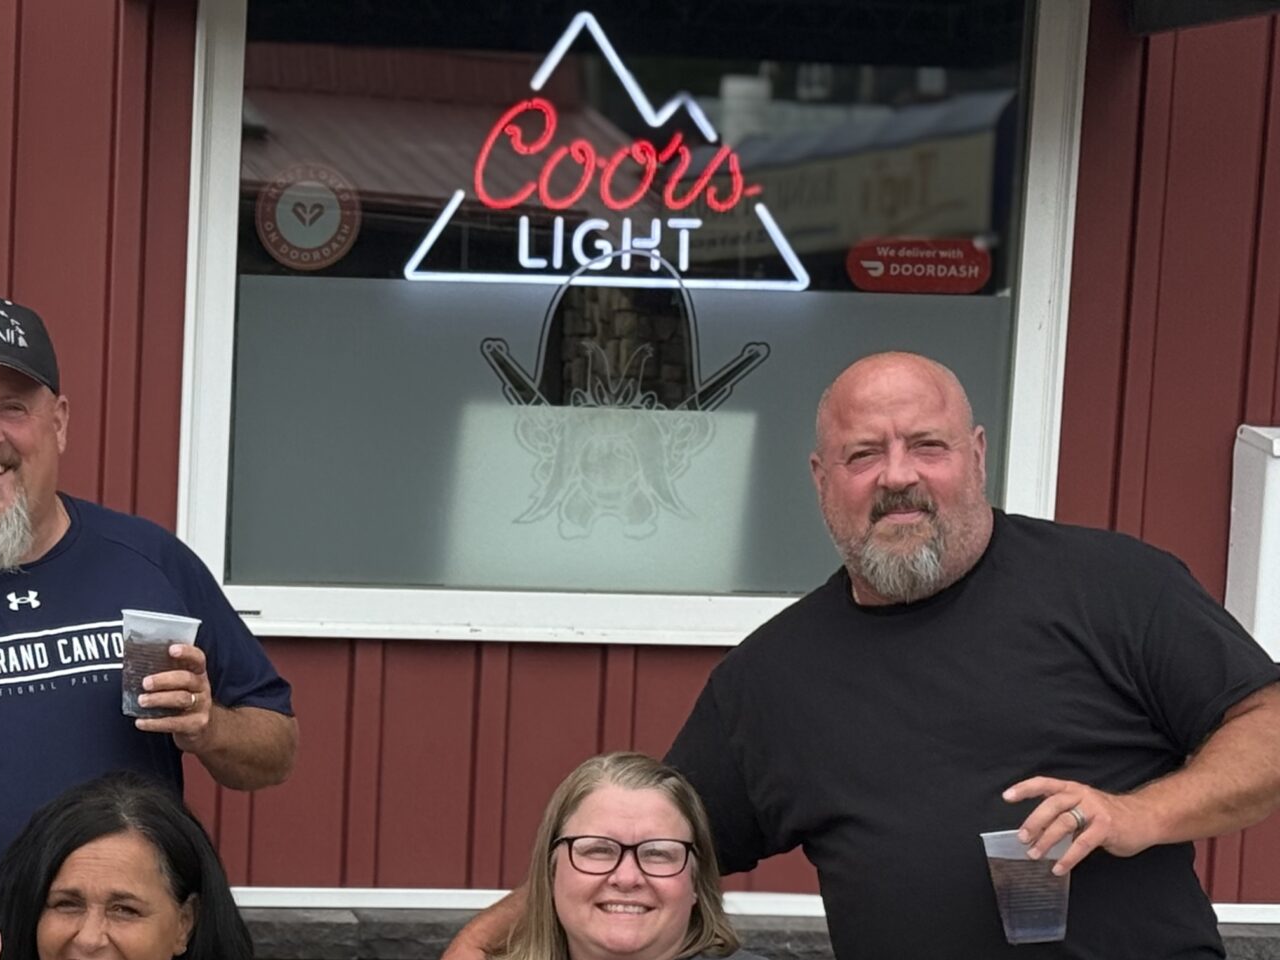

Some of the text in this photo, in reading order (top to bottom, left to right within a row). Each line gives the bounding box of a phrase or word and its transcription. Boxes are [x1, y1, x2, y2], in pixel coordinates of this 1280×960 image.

[474, 98, 762, 212] Coors
[263, 220, 351, 262] ON DOORDASH
[518, 215, 703, 272] LIGHT
[876, 246, 964, 259] We deliver with
[889, 263, 980, 278] DOORDASH
[57, 632, 124, 664] CANYO
[71, 673, 109, 687] PARK
